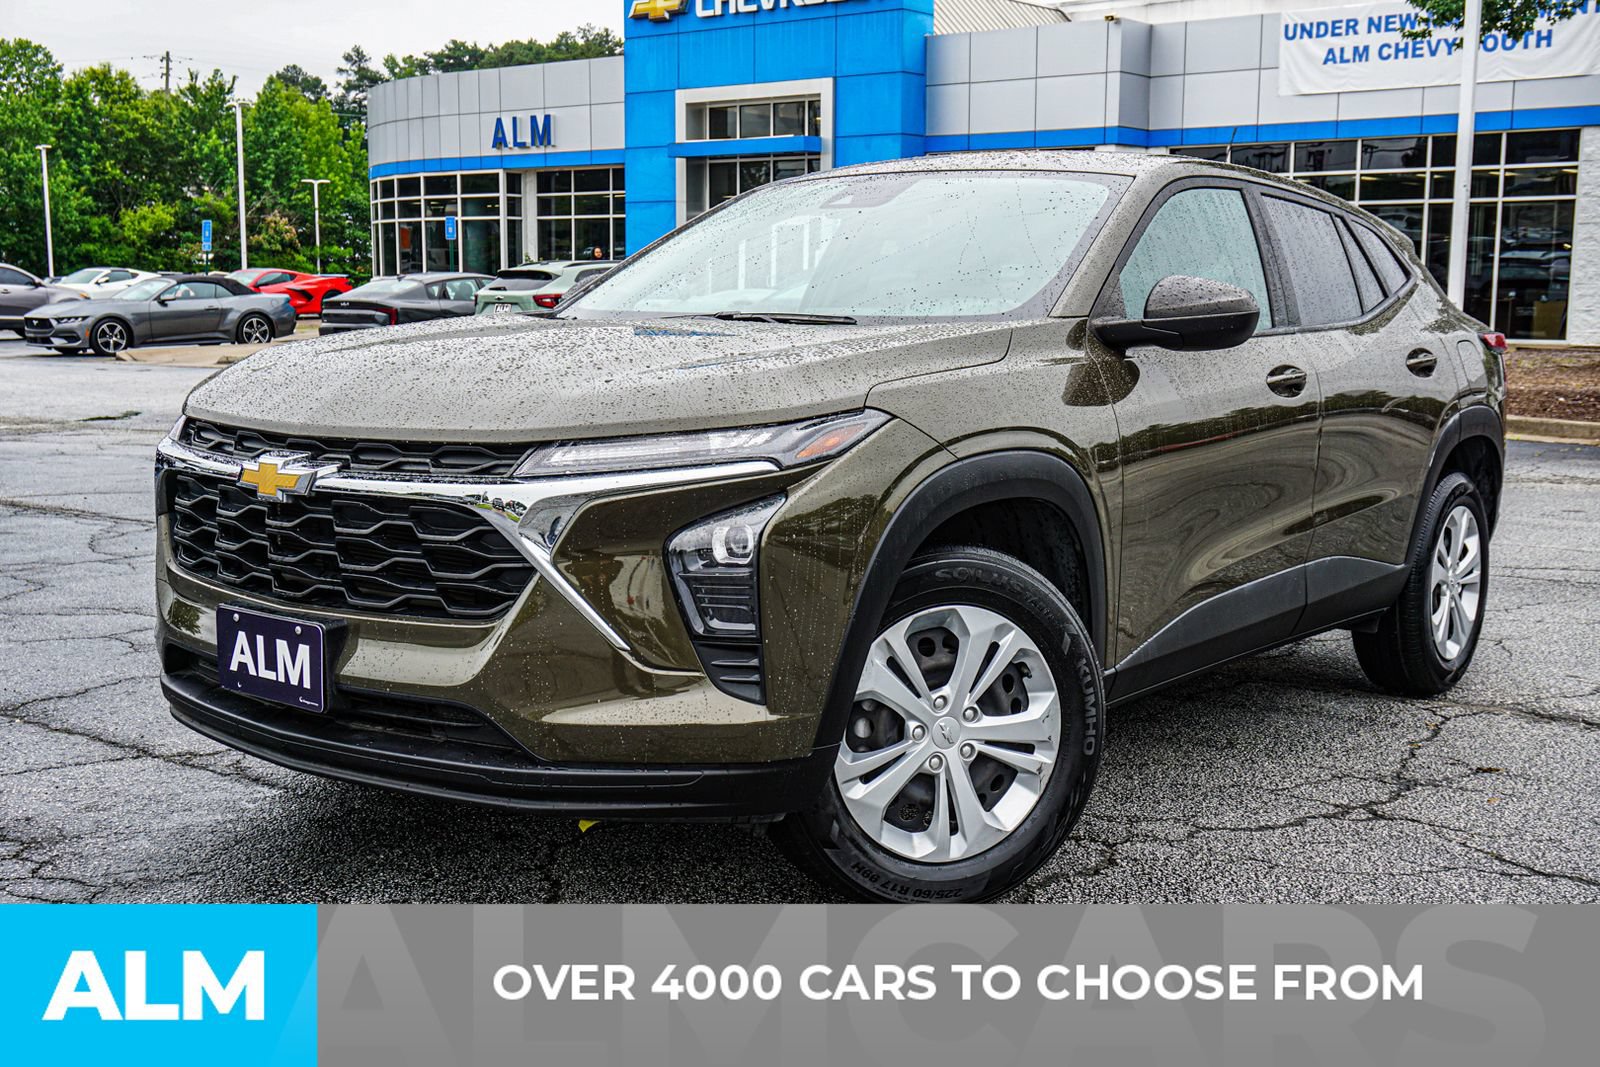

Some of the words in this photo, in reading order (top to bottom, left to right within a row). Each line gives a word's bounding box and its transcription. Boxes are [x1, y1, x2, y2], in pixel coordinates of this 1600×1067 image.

[1284, 18, 1358, 40] UNDER
[1367, 12, 1419, 33] NEW
[1322, 45, 1369, 65] ALM
[1377, 37, 1459, 60] CHEVY
[1481, 29, 1553, 53] OUTH
[491, 114, 552, 149] ALM
[229, 630, 311, 689] ALM
[1079, 658, 1097, 755] KUMHO
[851, 862, 880, 883] 99H
[880, 880, 911, 896] R17
[912, 888, 963, 899] 225/60
